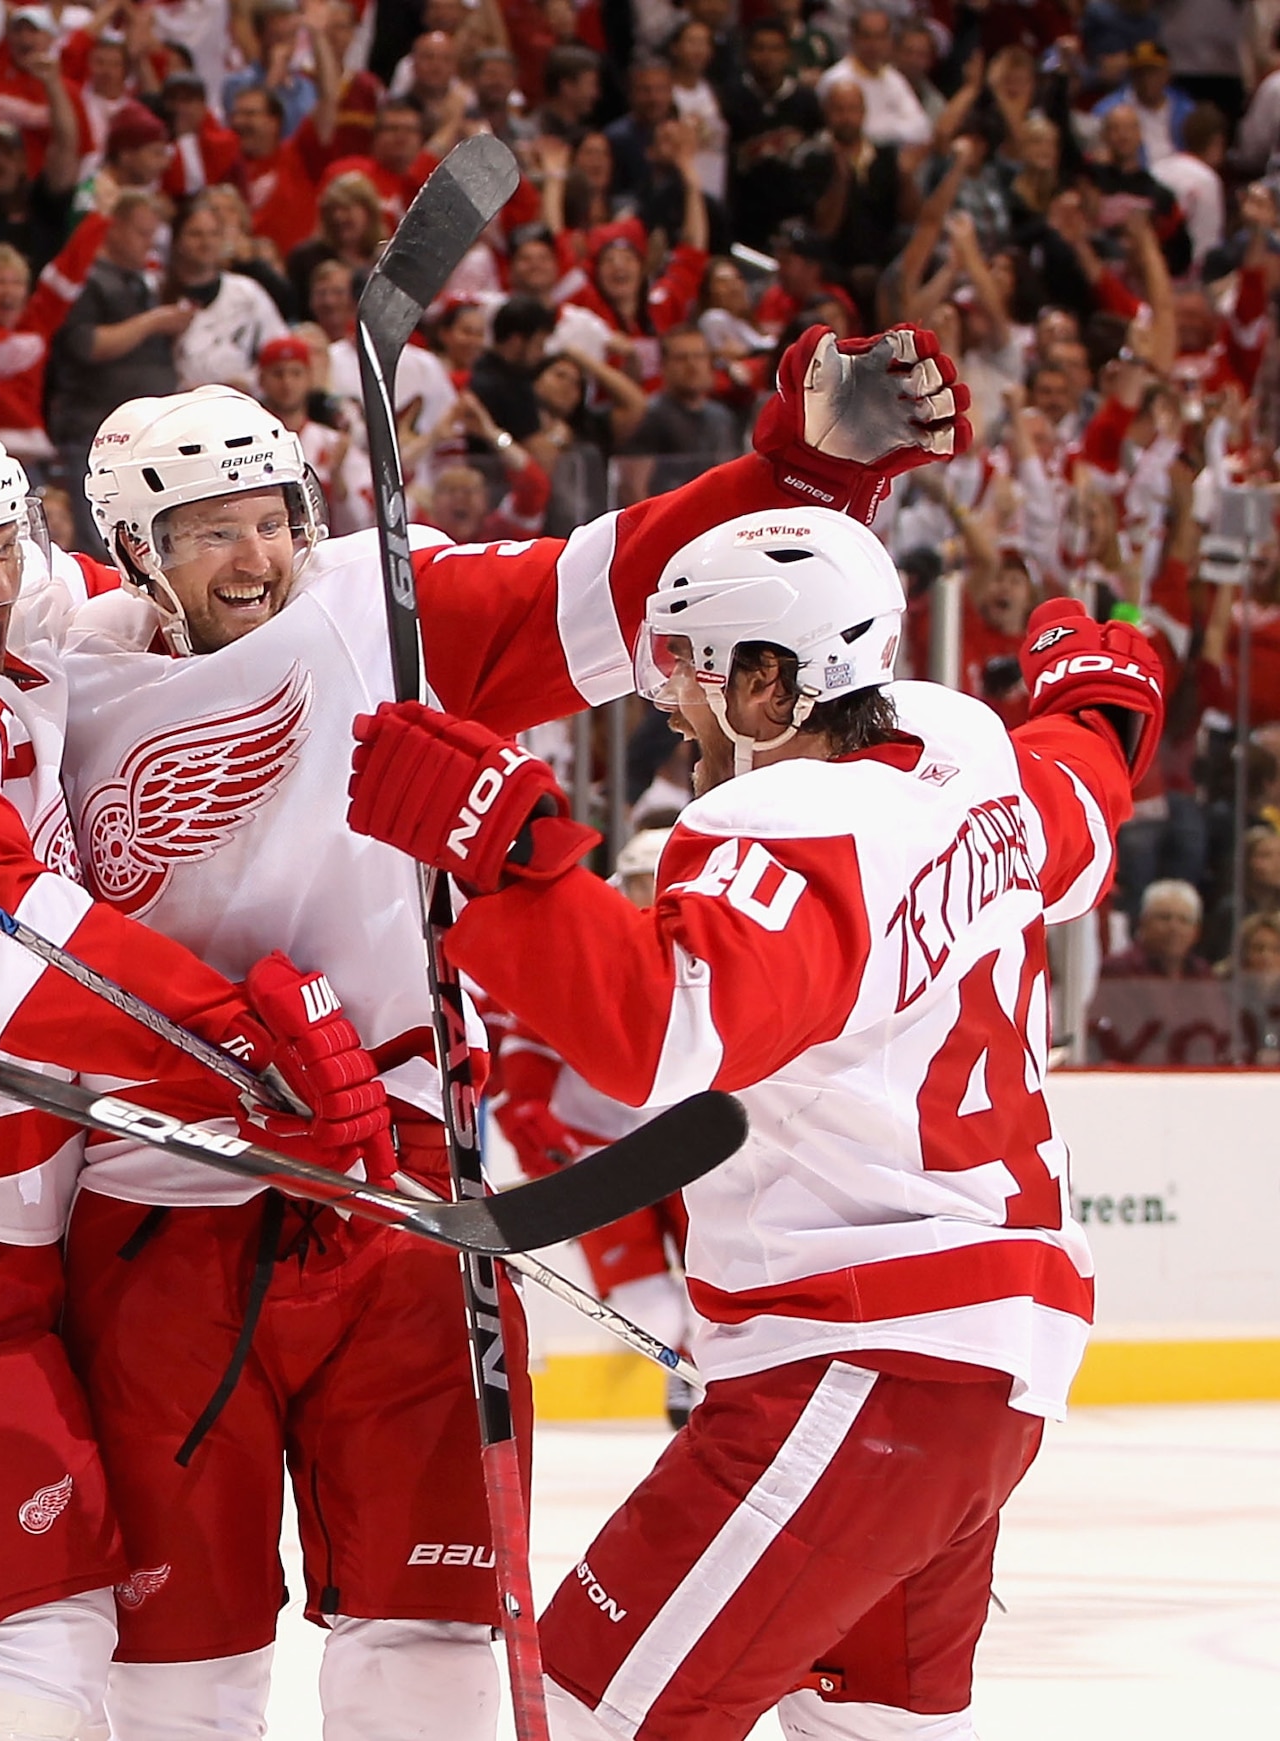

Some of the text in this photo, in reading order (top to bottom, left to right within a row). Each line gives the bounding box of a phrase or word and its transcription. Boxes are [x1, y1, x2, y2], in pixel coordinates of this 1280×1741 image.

[766, 525, 811, 537] Wings
[1033, 655, 1162, 699] TON
[446, 745, 544, 860] TON
